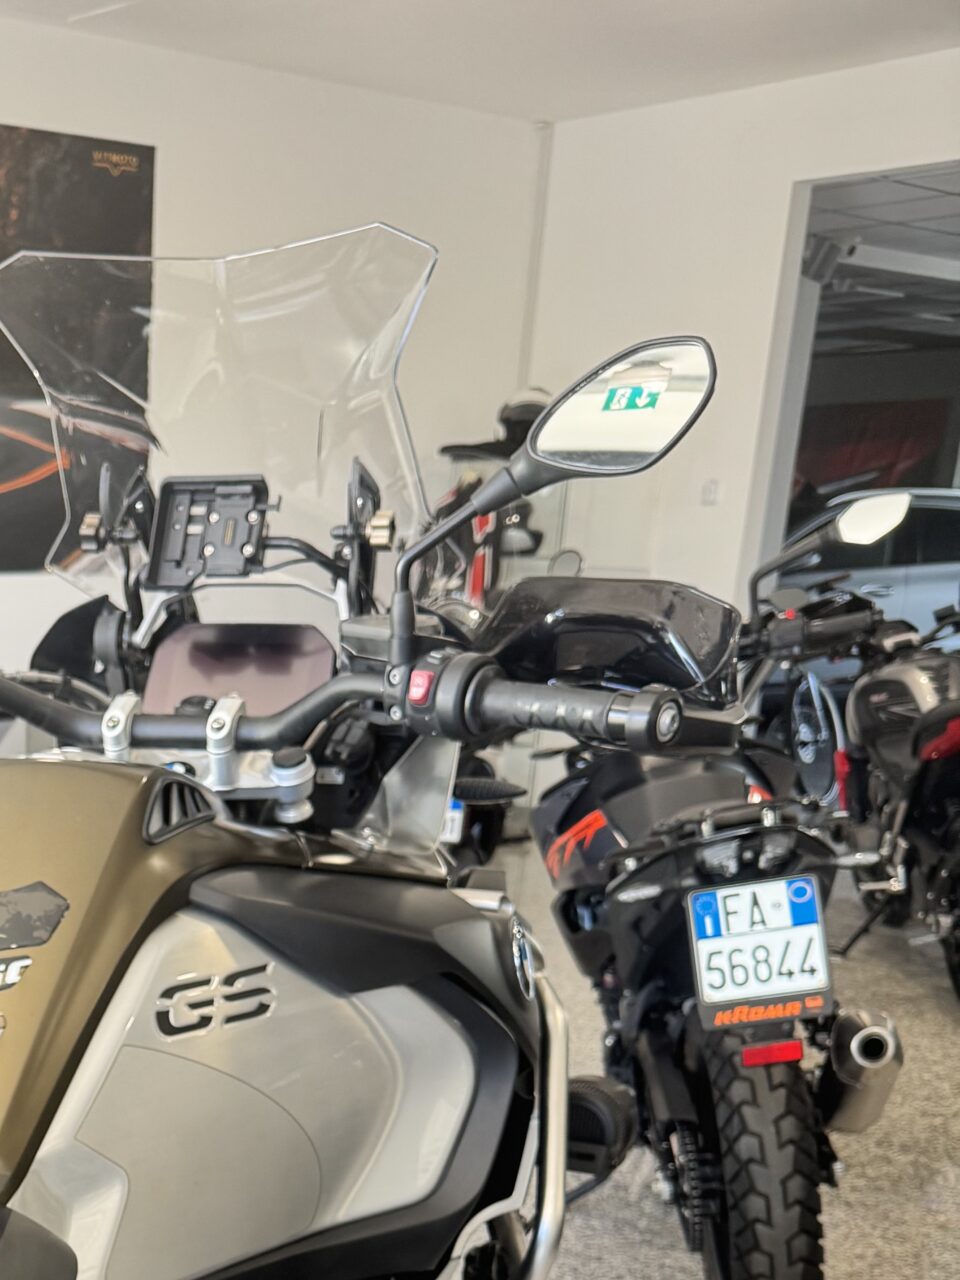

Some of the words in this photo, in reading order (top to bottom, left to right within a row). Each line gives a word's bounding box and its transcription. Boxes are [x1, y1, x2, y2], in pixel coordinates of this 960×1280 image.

[722, 890, 767, 934] FA
[706, 936, 817, 990] 56844
[155, 963, 273, 1038] GS
